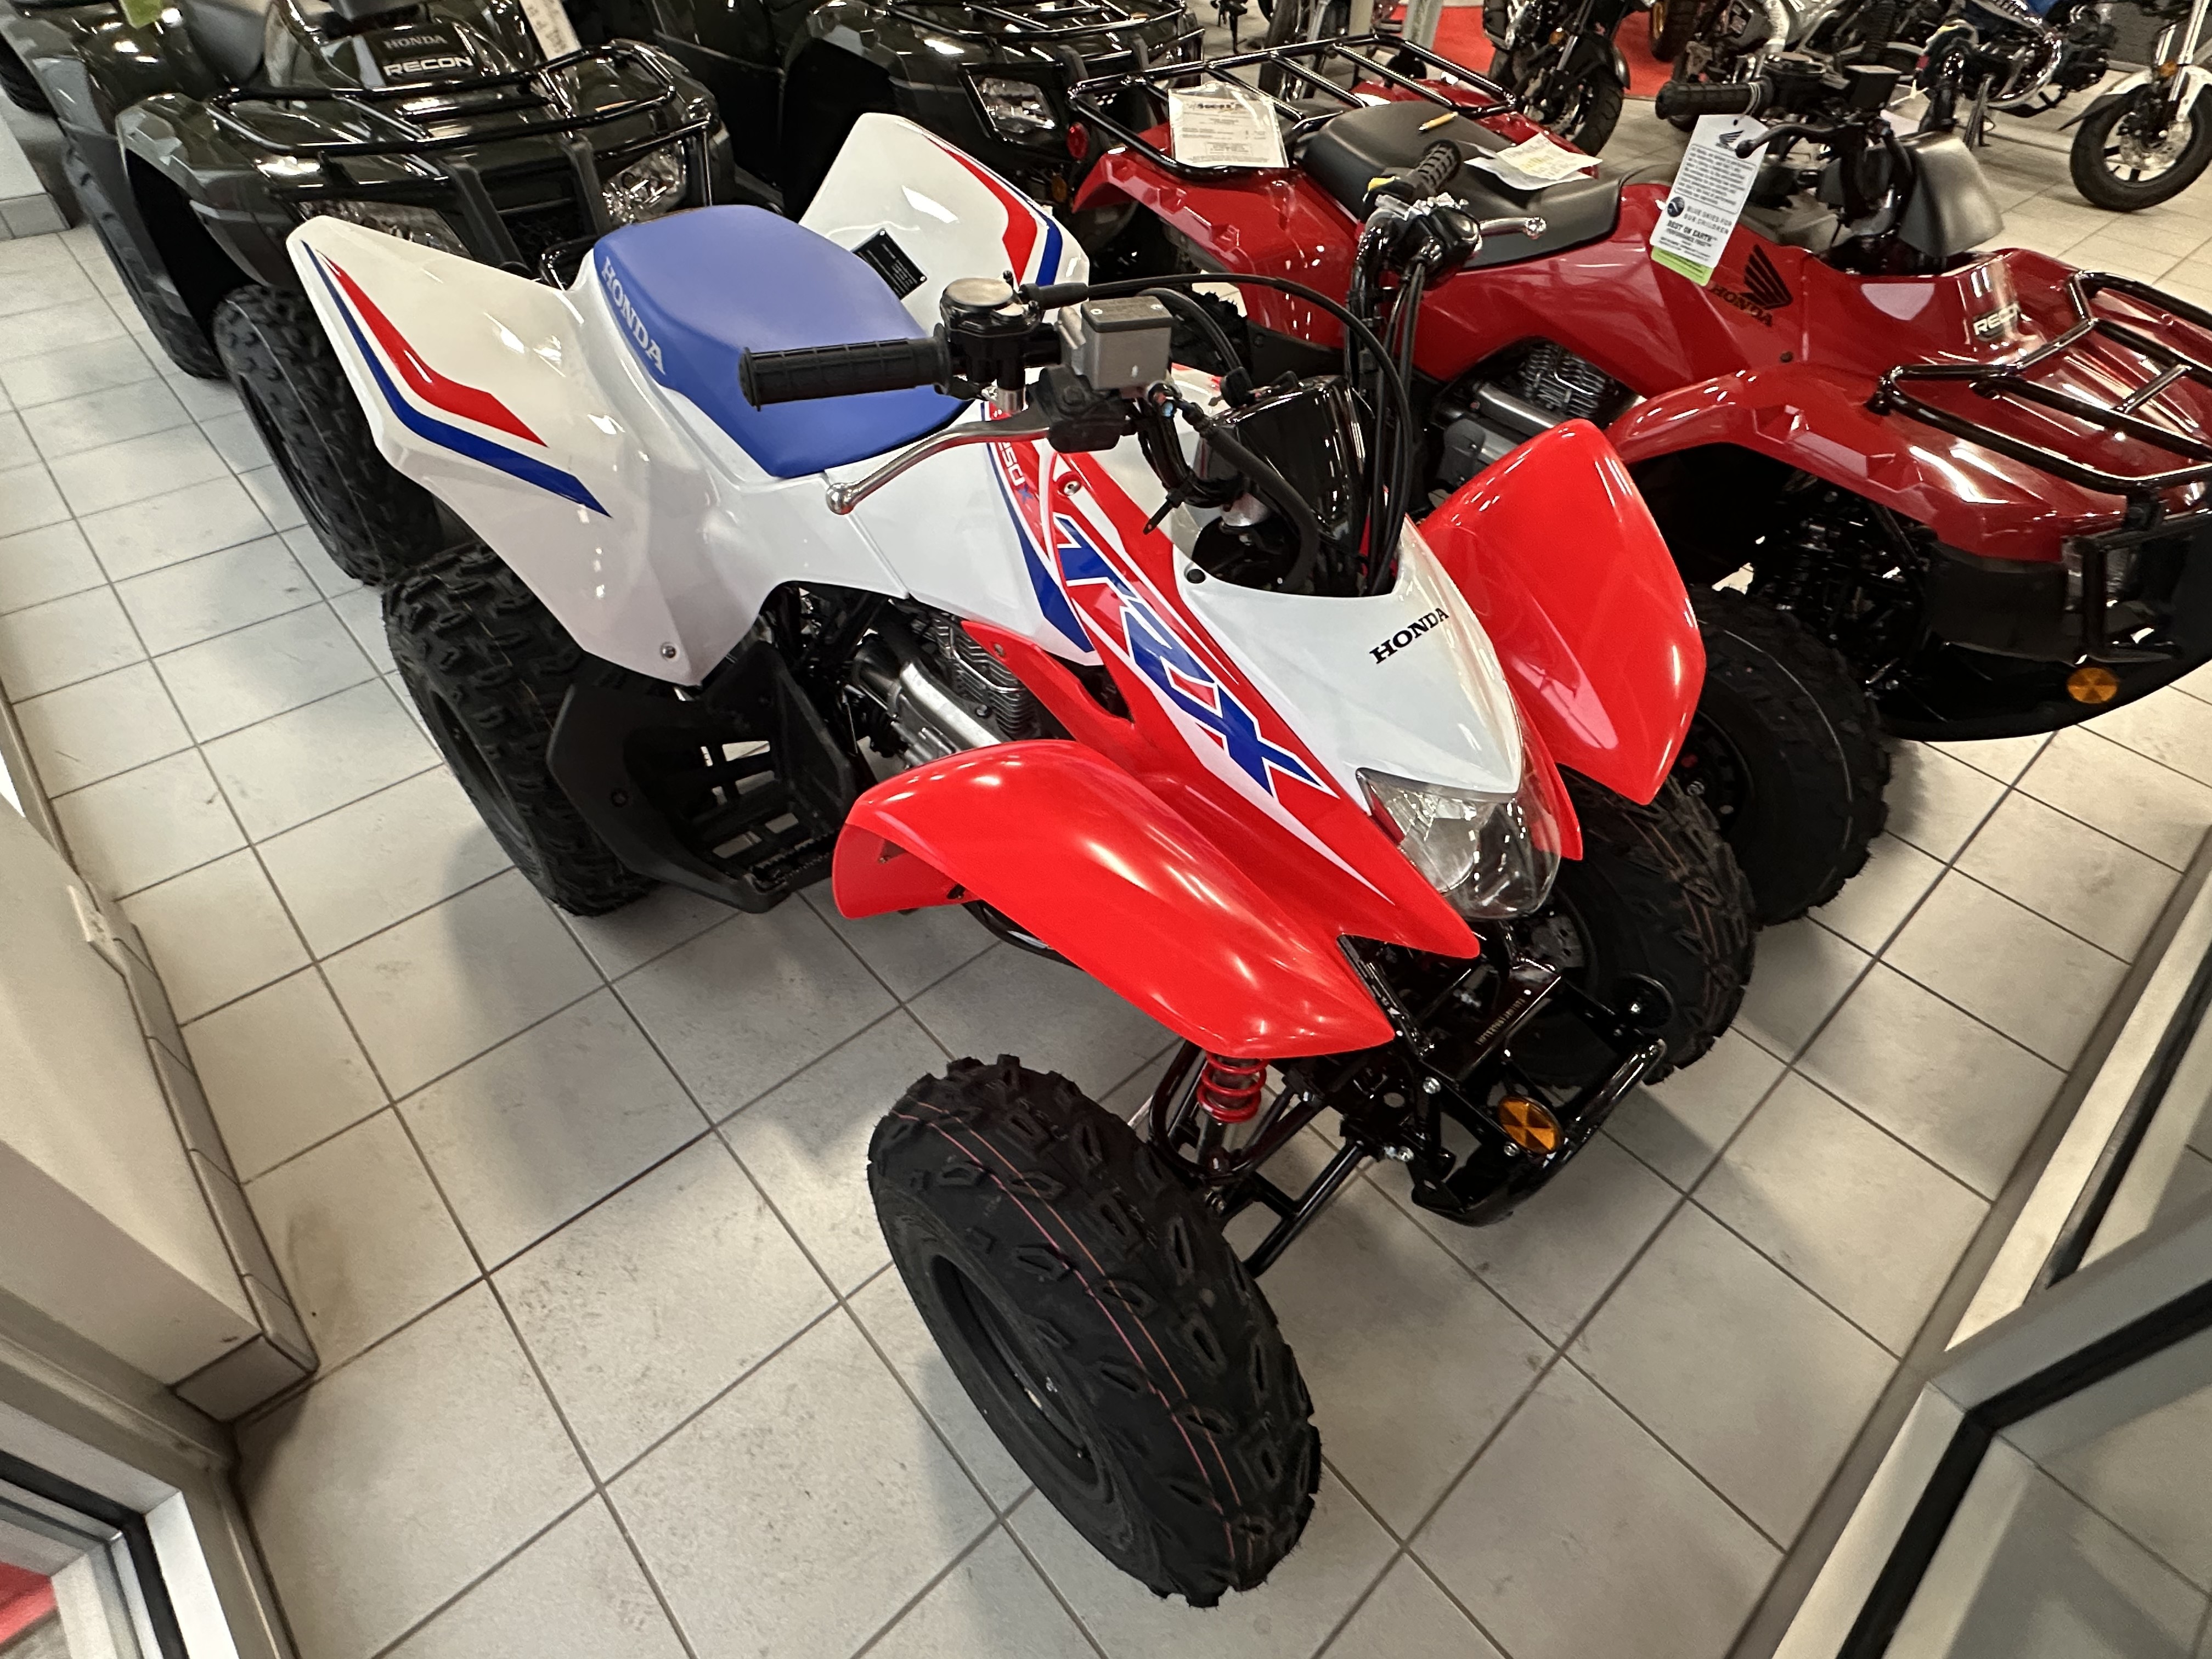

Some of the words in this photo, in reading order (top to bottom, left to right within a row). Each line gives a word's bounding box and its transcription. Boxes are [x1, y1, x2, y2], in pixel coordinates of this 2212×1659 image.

[383, 35, 448, 49] HONDA
[383, 57, 473, 76] RECON
[1667, 220, 1683, 230] BEST
[602, 256, 666, 375] HONDA
[1708, 284, 1773, 328] HONDA
[1973, 303, 2019, 335] RECO
[1369, 608, 1449, 664] HONDA
[1052, 513, 1340, 800] TRX
